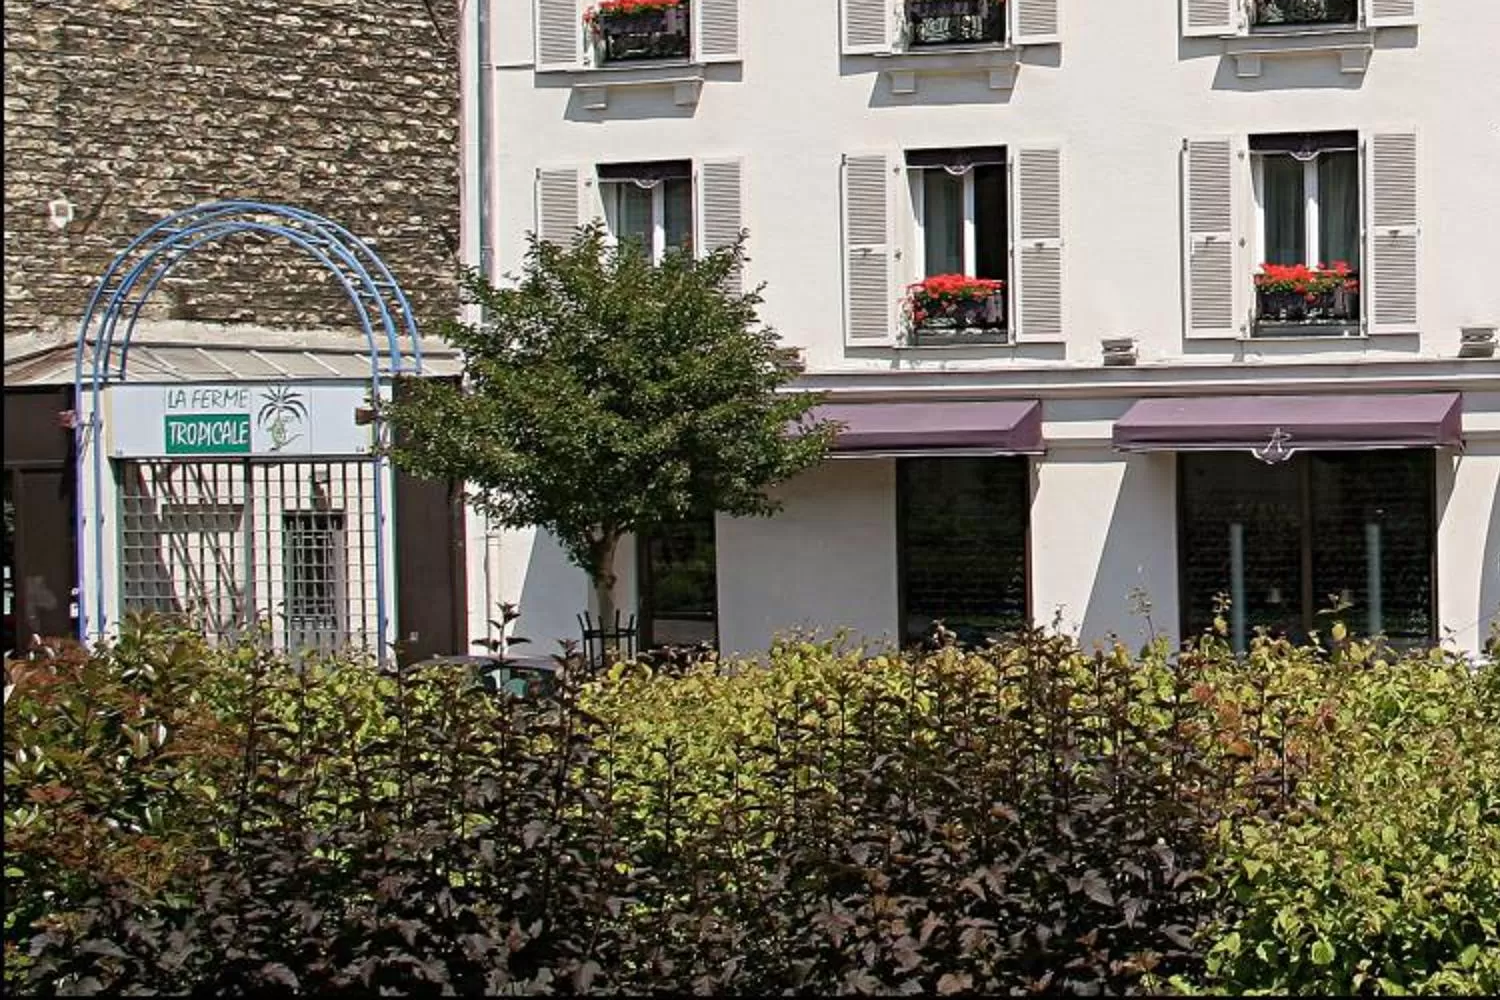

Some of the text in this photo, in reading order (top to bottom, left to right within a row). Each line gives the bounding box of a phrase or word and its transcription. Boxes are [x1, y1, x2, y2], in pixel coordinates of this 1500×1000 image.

[167, 388, 250, 409] LA FERME
[168, 420, 249, 447] TROPICALE
